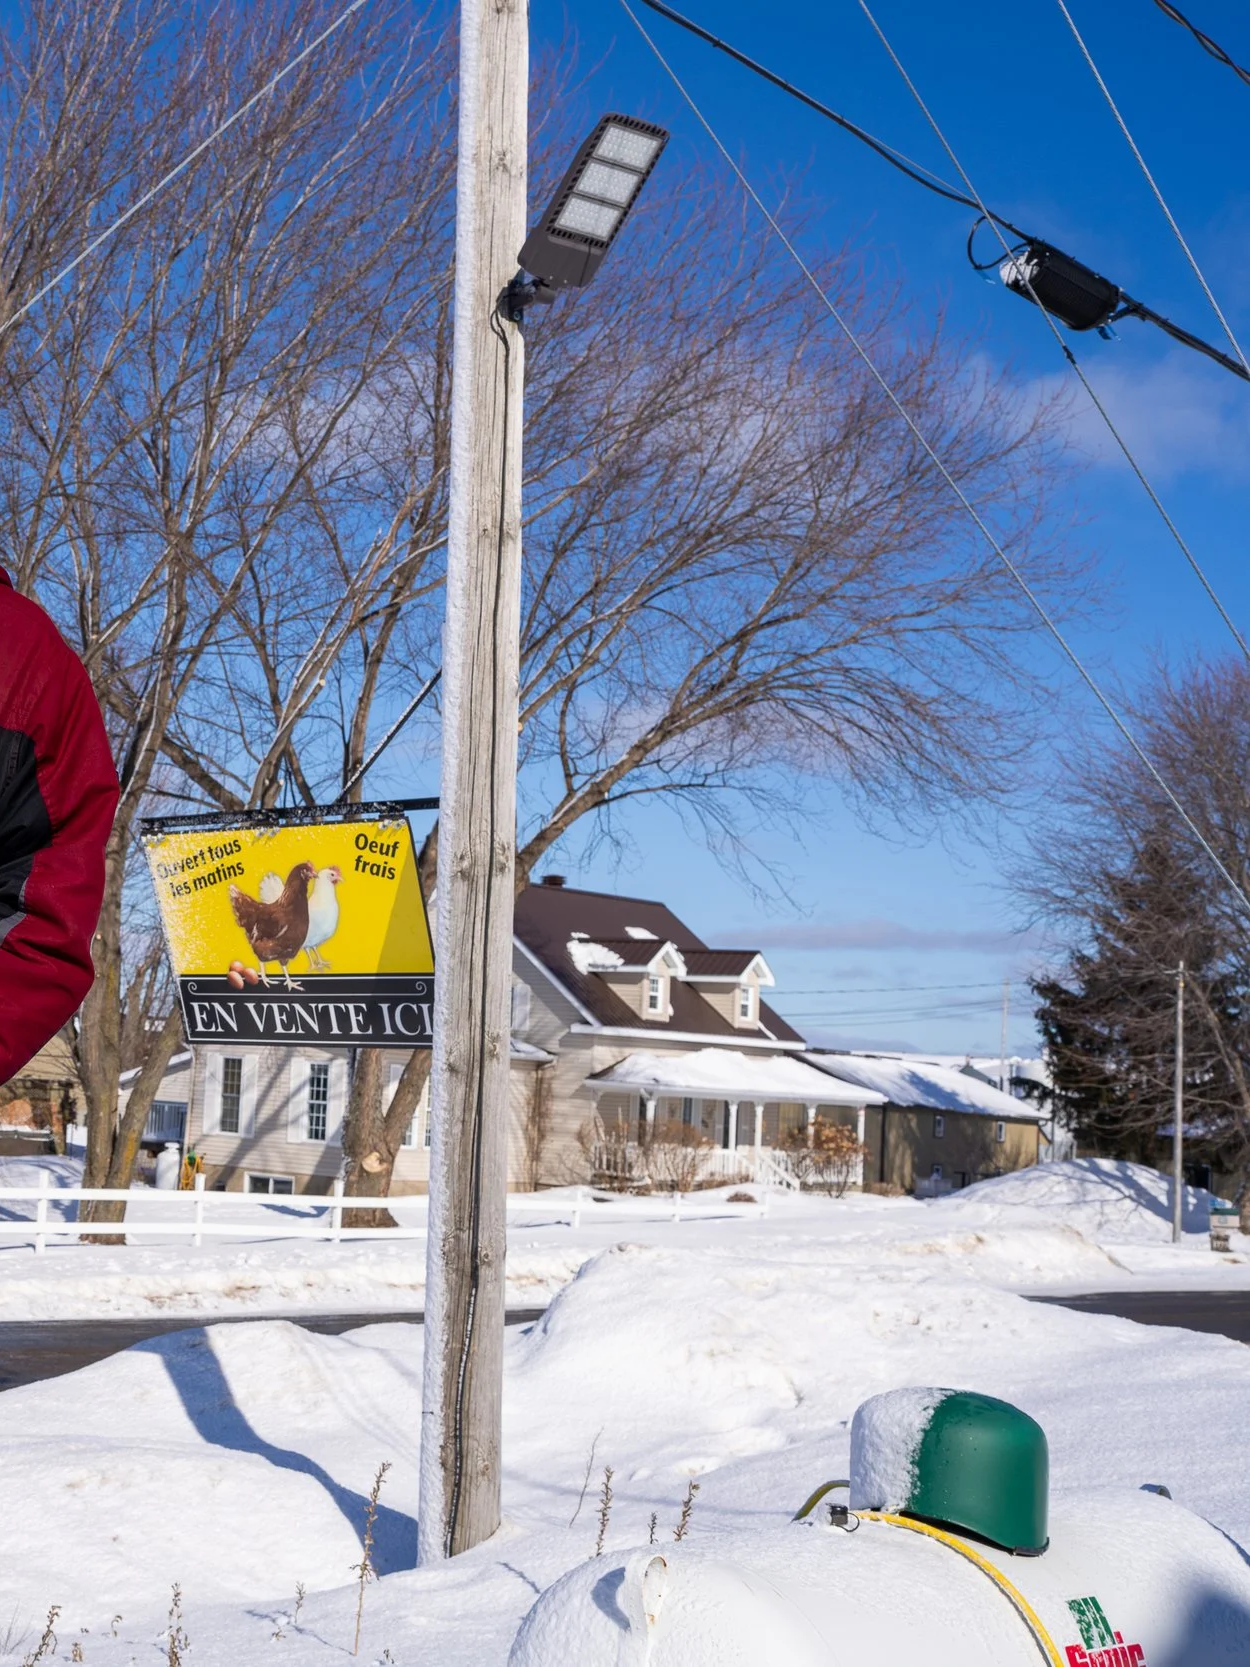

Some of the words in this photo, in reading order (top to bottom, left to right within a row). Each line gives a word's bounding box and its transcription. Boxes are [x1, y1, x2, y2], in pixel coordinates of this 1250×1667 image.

[157, 849, 206, 879] Ouvert
[208, 839, 242, 862] tous
[354, 833, 400, 858] Oeuf
[169, 881, 192, 898] les
[193, 862, 245, 891] matins
[354, 855, 397, 880] frais
[190, 1002, 239, 1033] EN
[244, 1002, 373, 1035] VENTE
[378, 1002, 434, 1036] ICI
